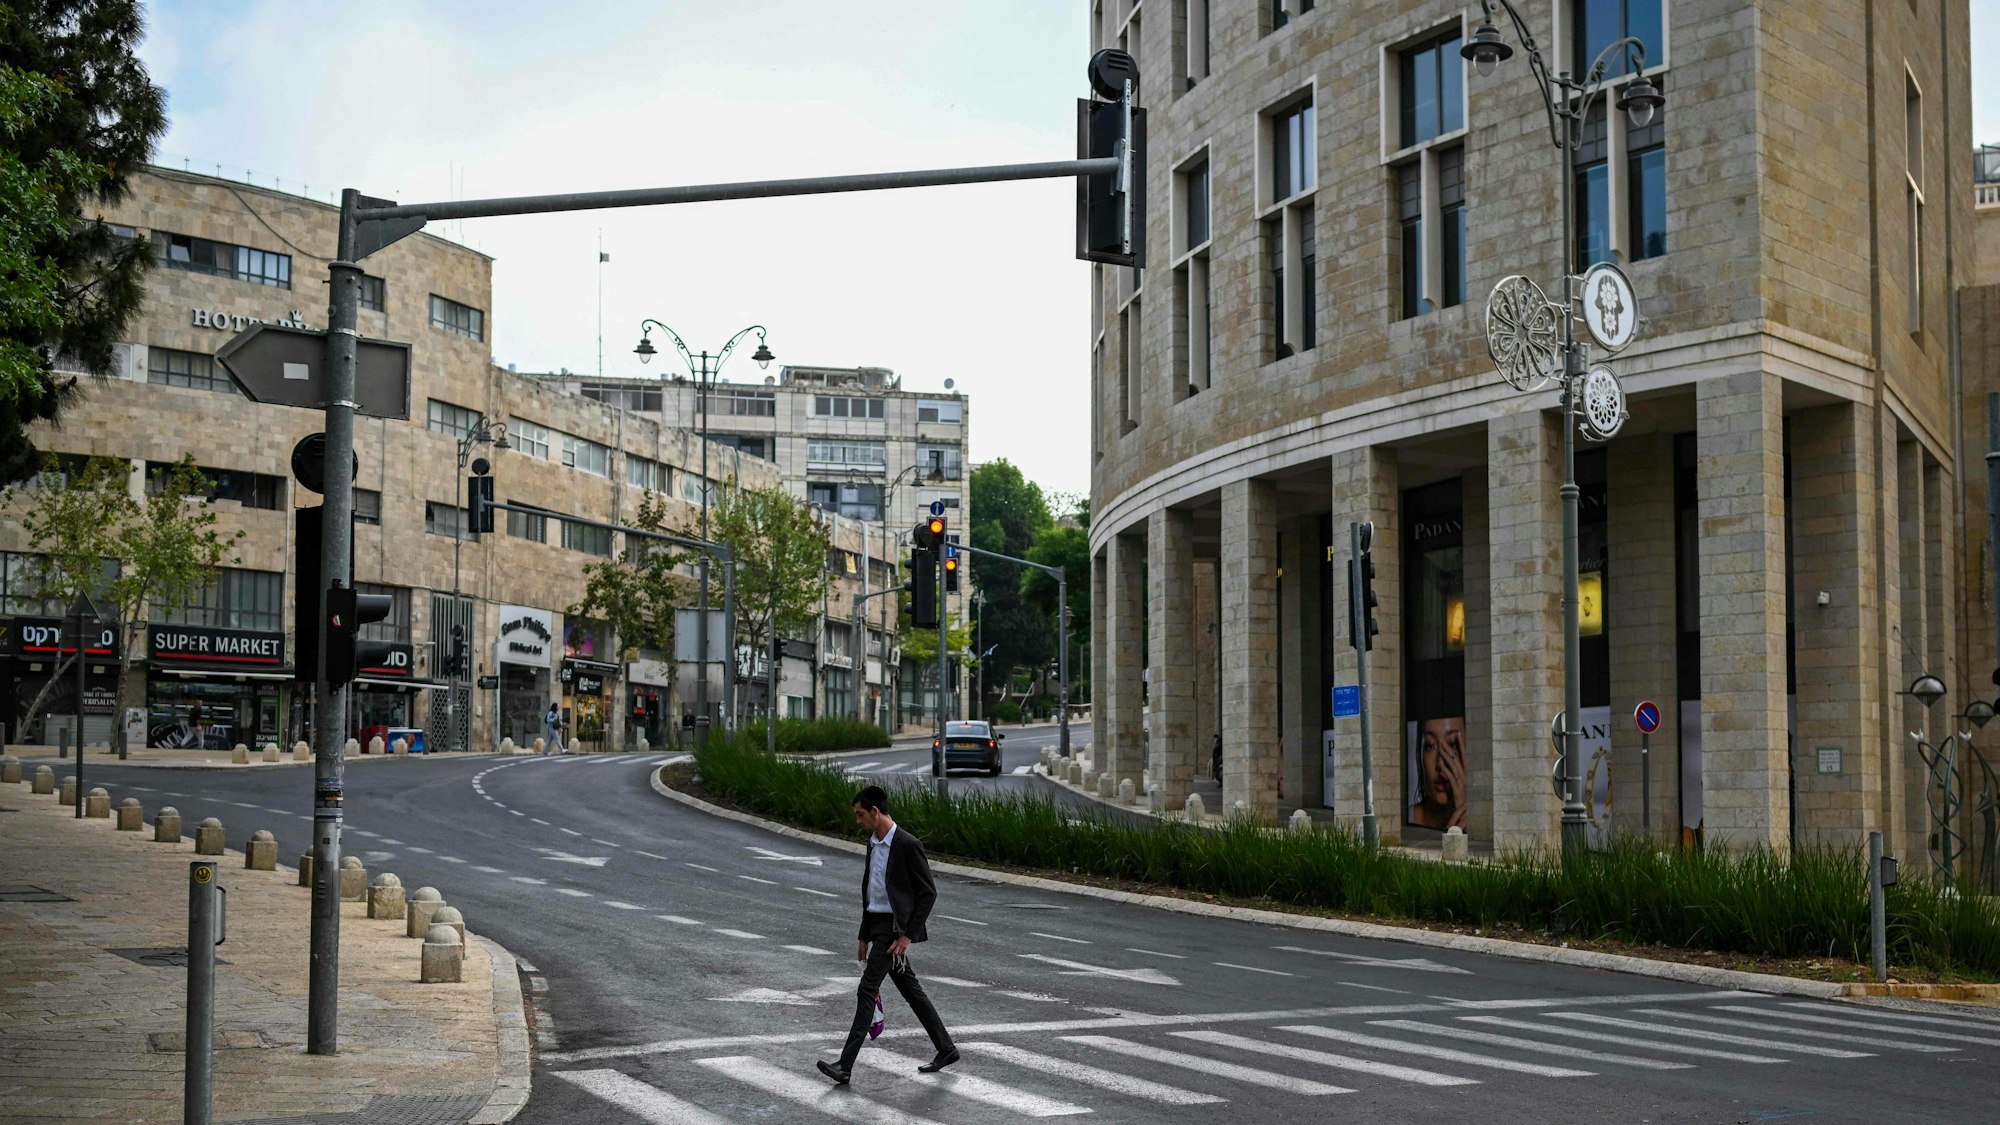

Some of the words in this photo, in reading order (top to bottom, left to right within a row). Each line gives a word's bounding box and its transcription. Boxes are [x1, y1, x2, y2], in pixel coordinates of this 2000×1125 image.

[193, 307, 267, 333] HOT
[155, 633, 209, 652] SUPER
[215, 637, 280, 655] MARKET
